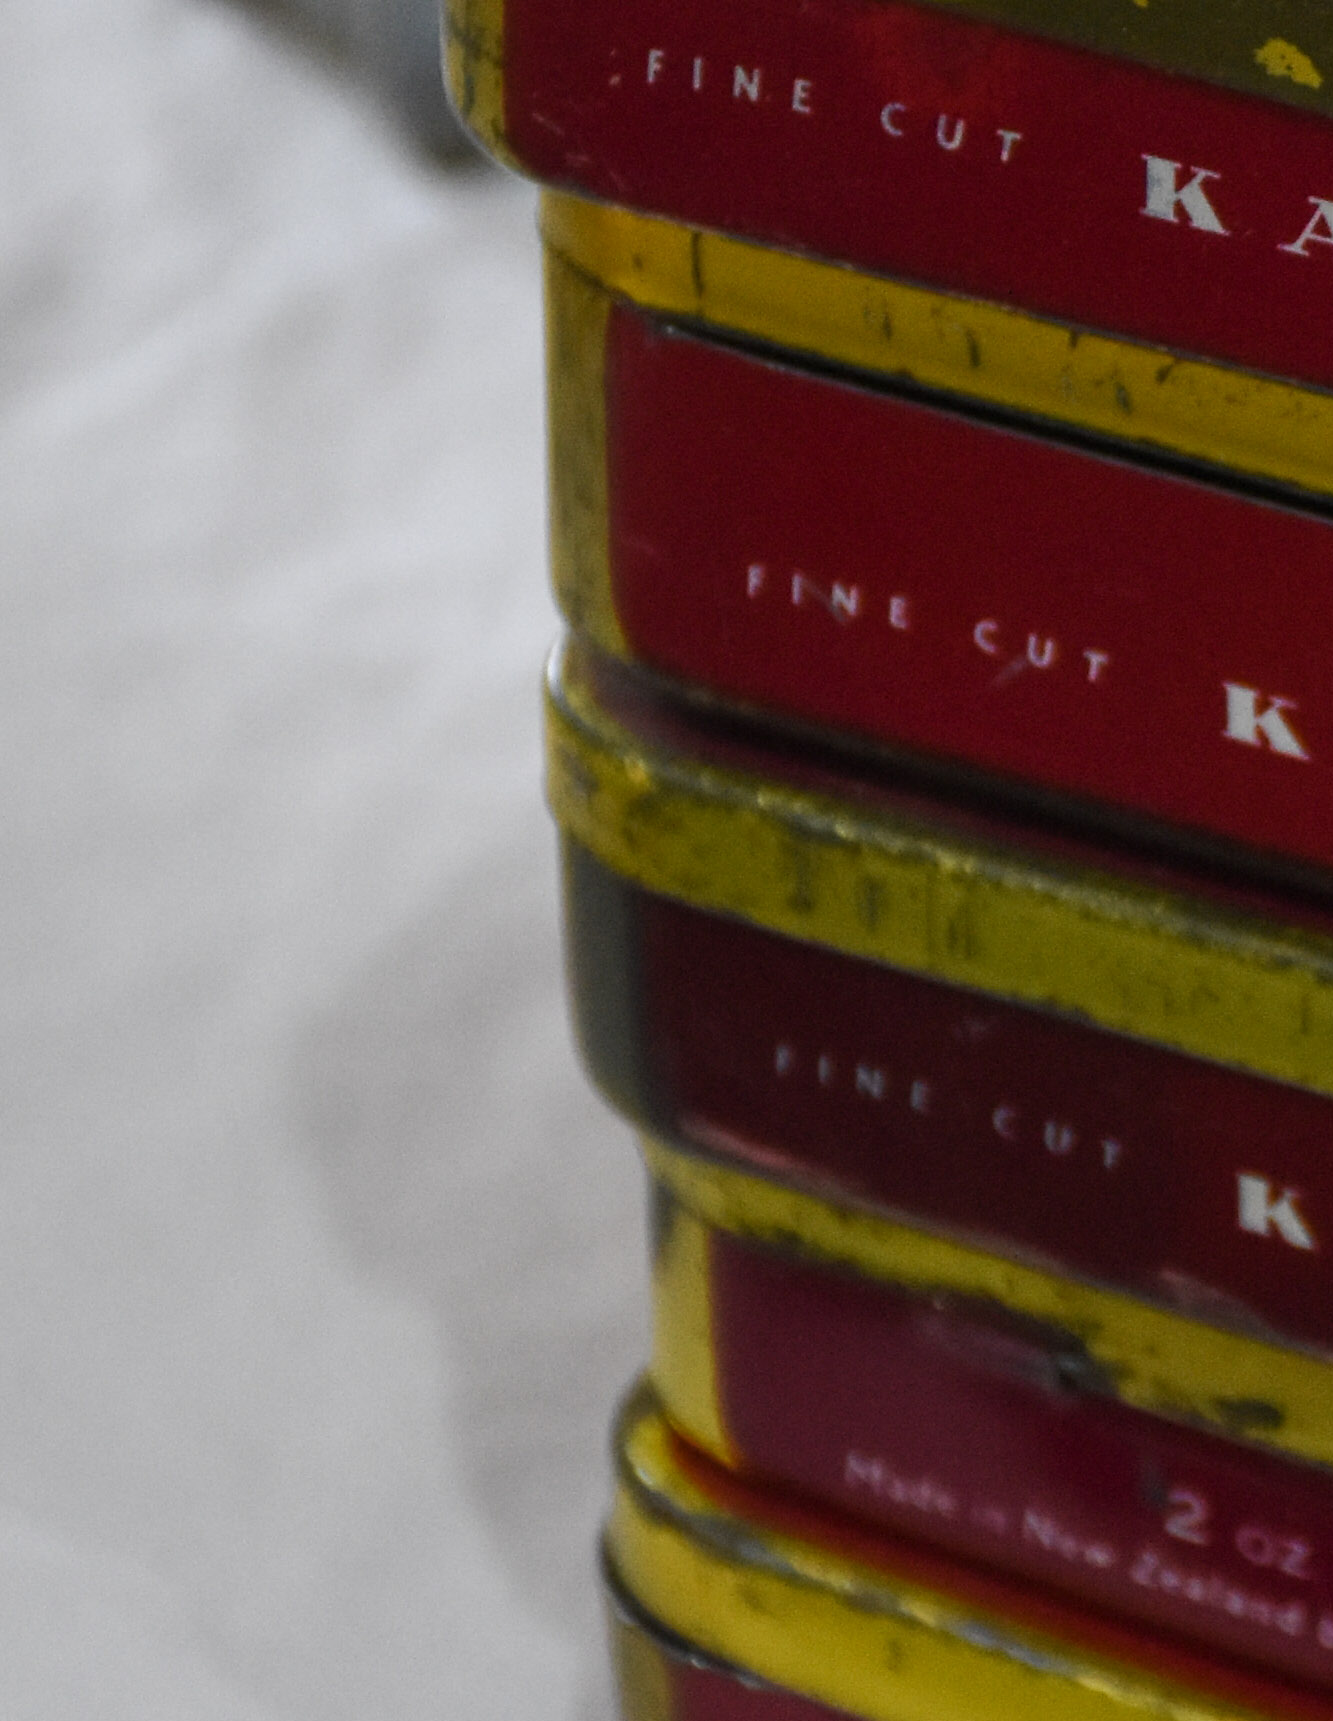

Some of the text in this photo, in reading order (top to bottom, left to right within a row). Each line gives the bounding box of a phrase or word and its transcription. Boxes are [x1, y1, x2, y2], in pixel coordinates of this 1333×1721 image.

[648, 49, 812, 112] FINE
[881, 102, 1022, 165] CUT
[746, 565, 911, 631] FINE
[973, 619, 1109, 682] CUT
[775, 1044, 932, 1115] FINE
[992, 1106, 1123, 1169] CUT
[1162, 1488, 1213, 1546] 2
